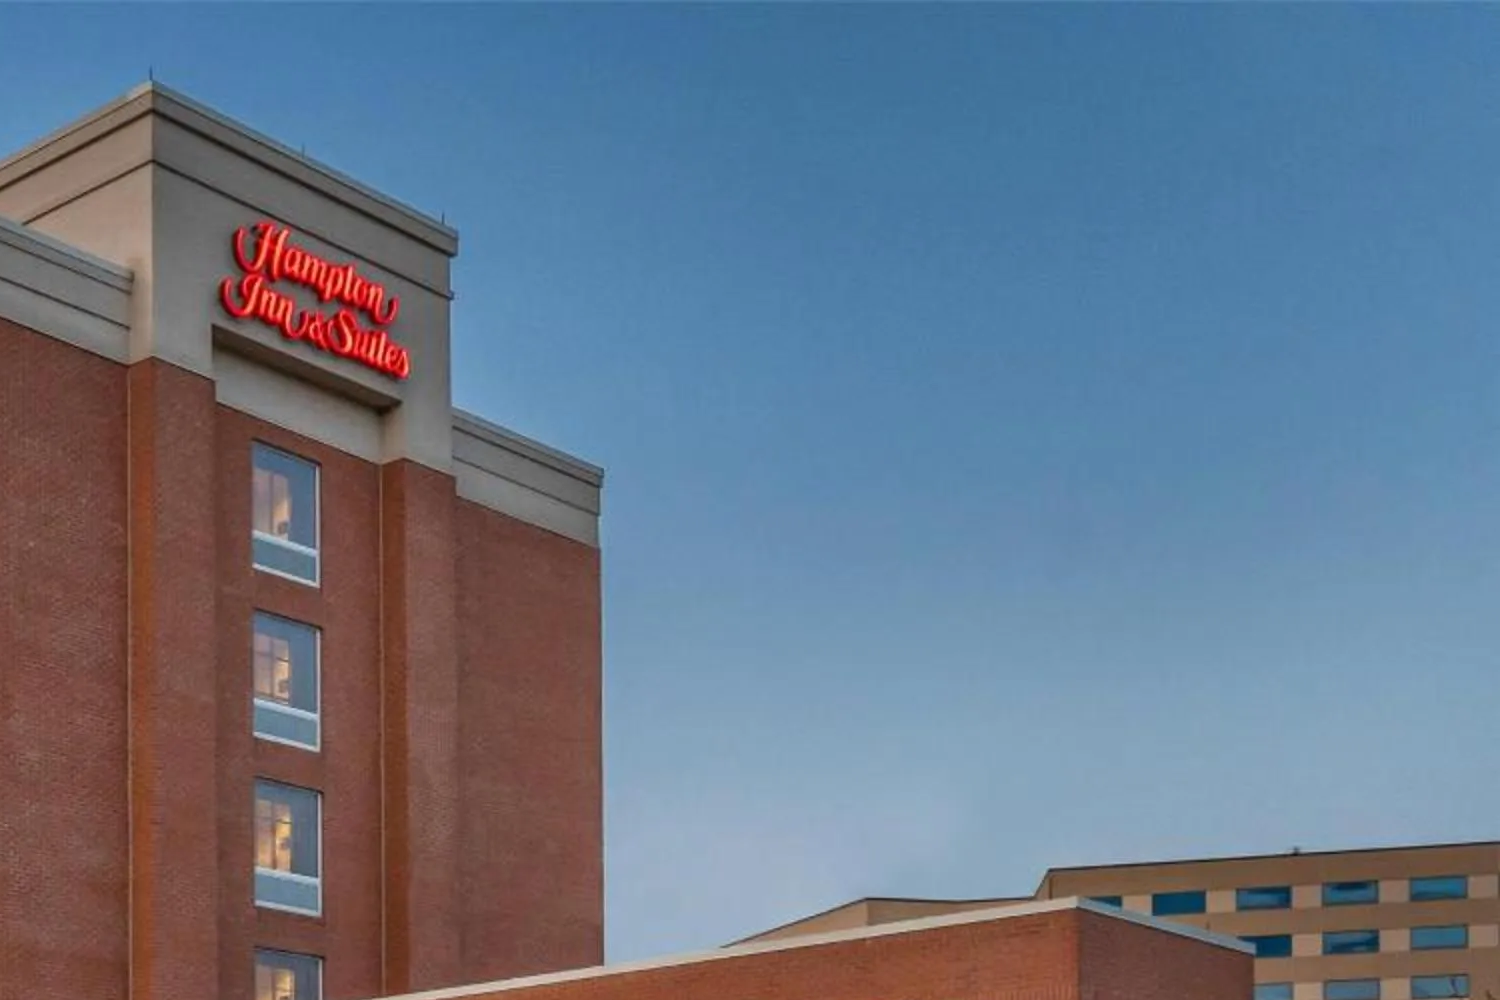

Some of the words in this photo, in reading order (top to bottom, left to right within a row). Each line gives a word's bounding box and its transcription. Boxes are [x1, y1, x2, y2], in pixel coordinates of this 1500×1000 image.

[233, 221, 400, 325] Hampton
[220, 273, 309, 340] Inn
[308, 311, 330, 349] &
[327, 308, 411, 380] Suites
